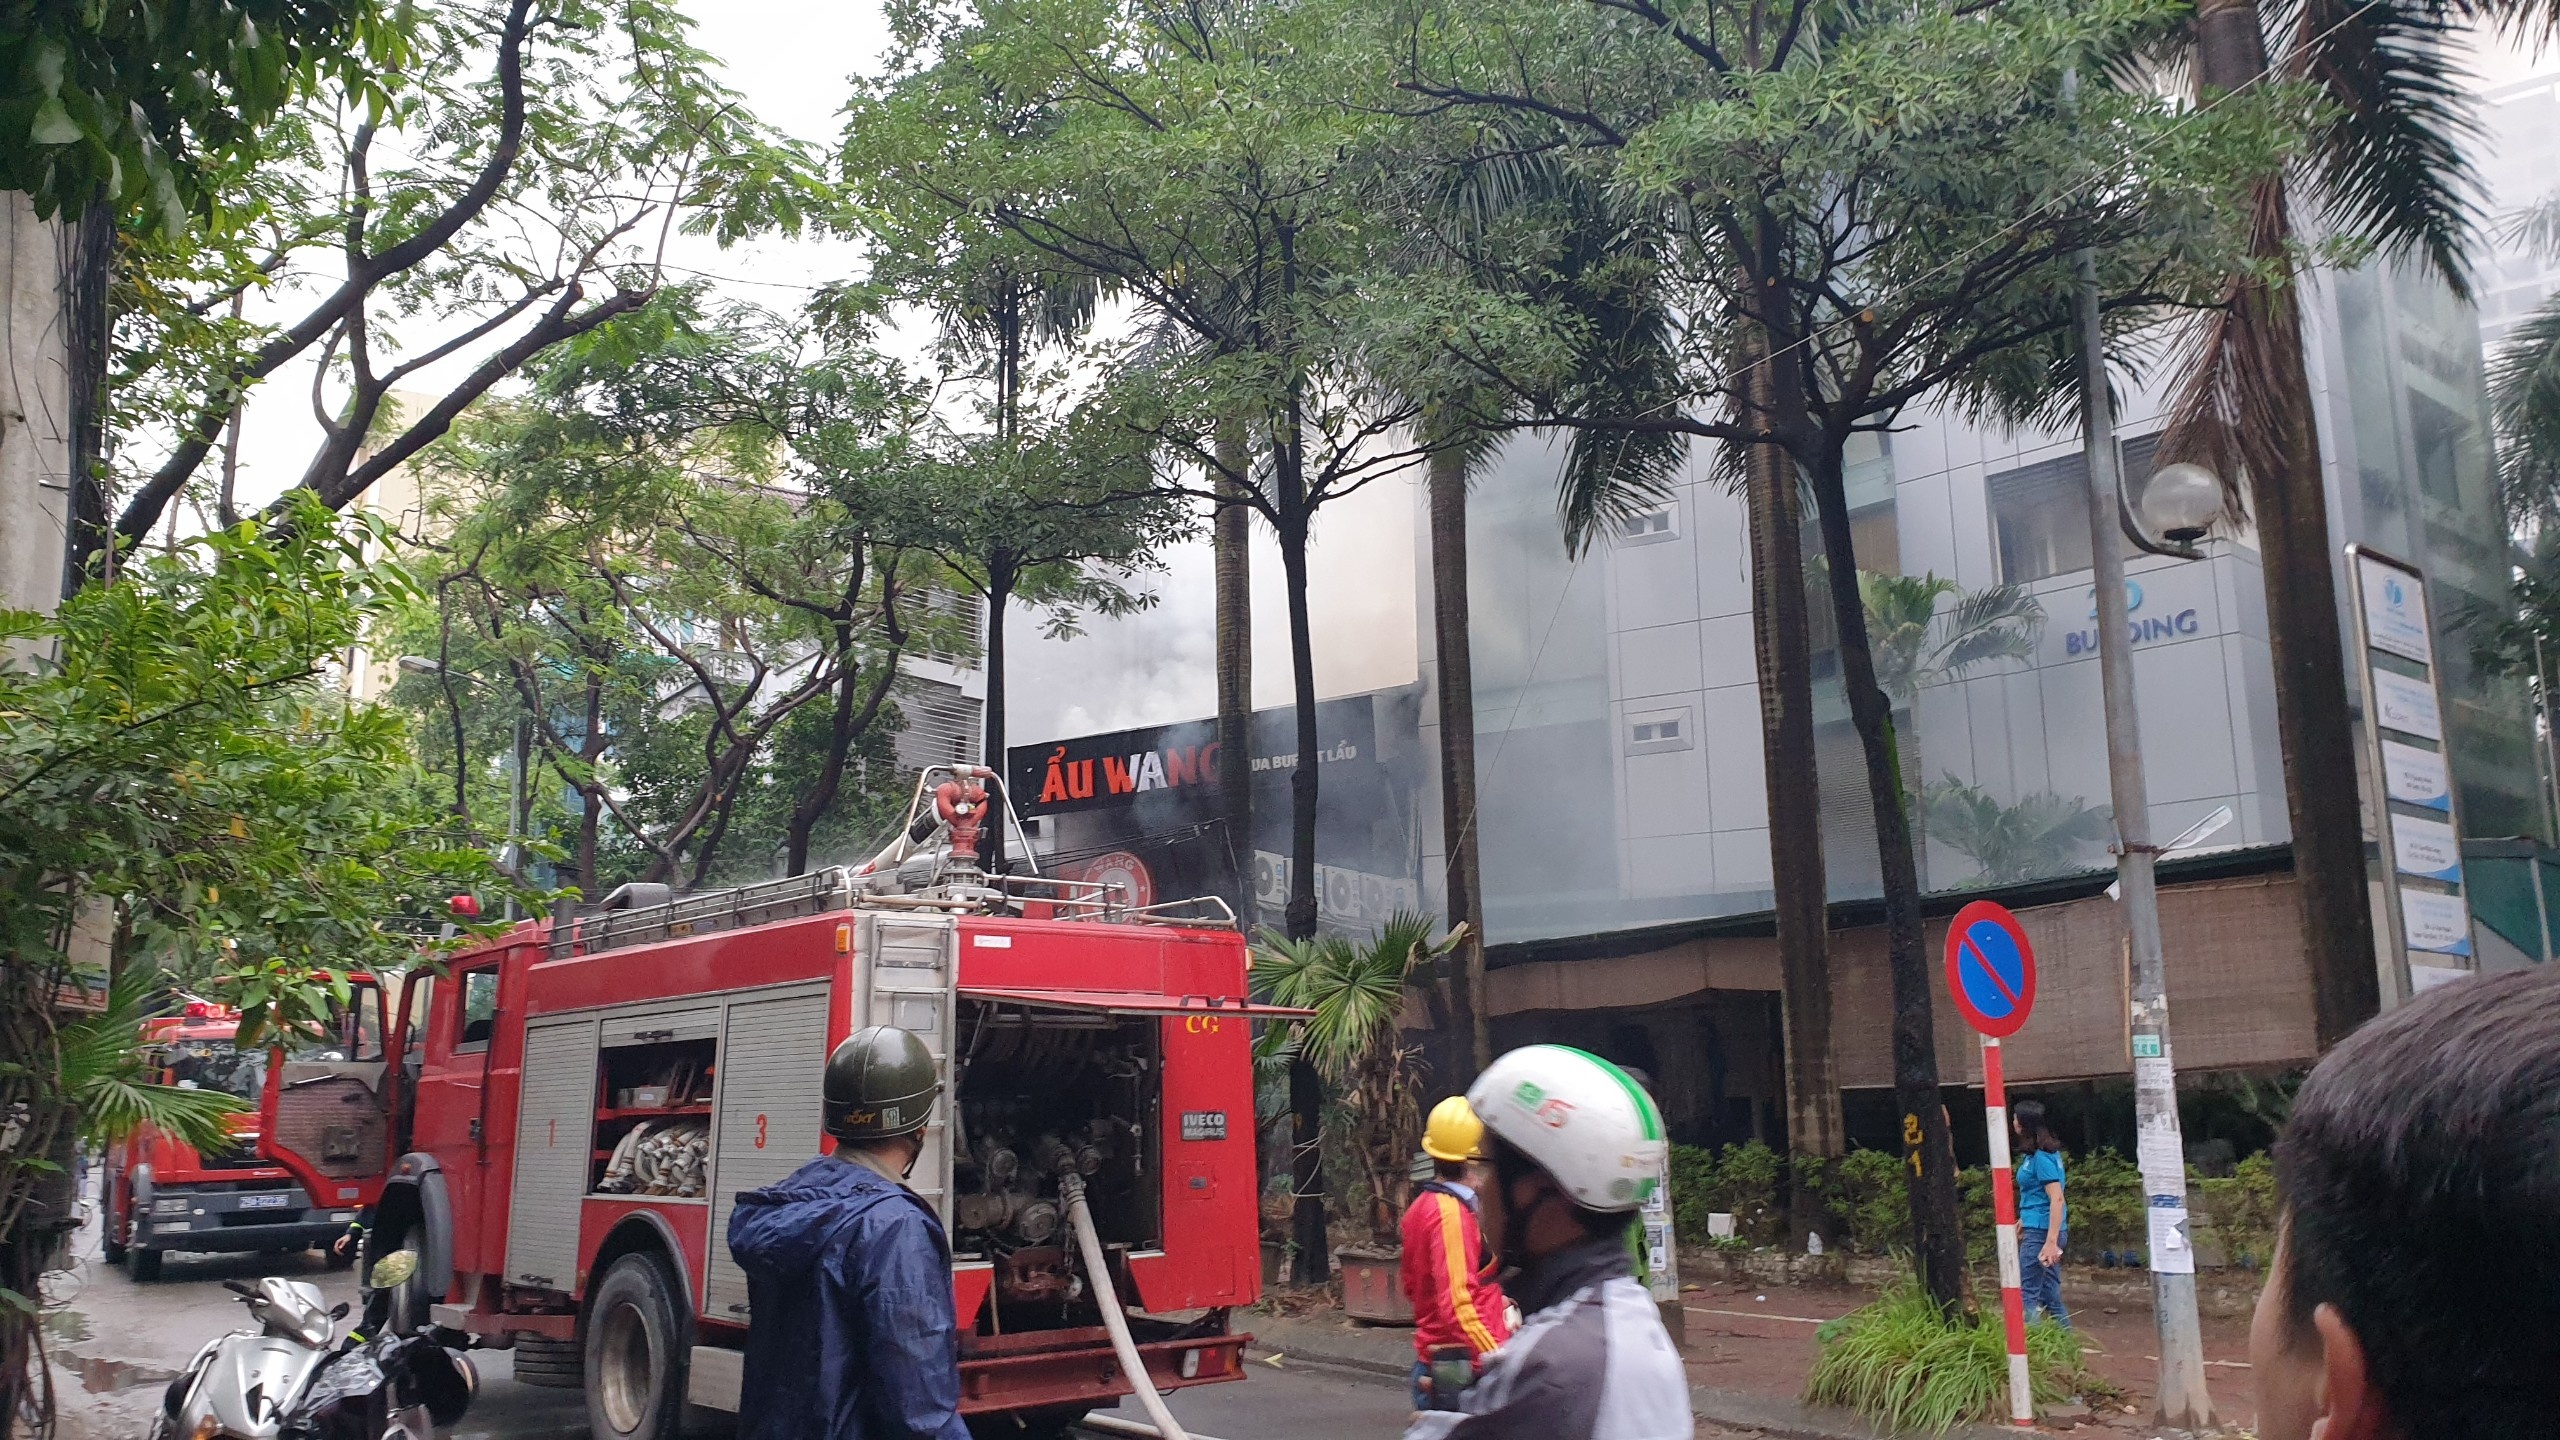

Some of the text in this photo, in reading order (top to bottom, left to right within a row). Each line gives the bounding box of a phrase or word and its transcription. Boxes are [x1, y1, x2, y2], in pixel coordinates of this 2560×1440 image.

[2066, 608, 2197, 656] BUDING
[1272, 751, 1326, 769] BUFT
[755, 1113, 767, 1149] 3
[1183, 1114, 1225, 1126] IVECO
